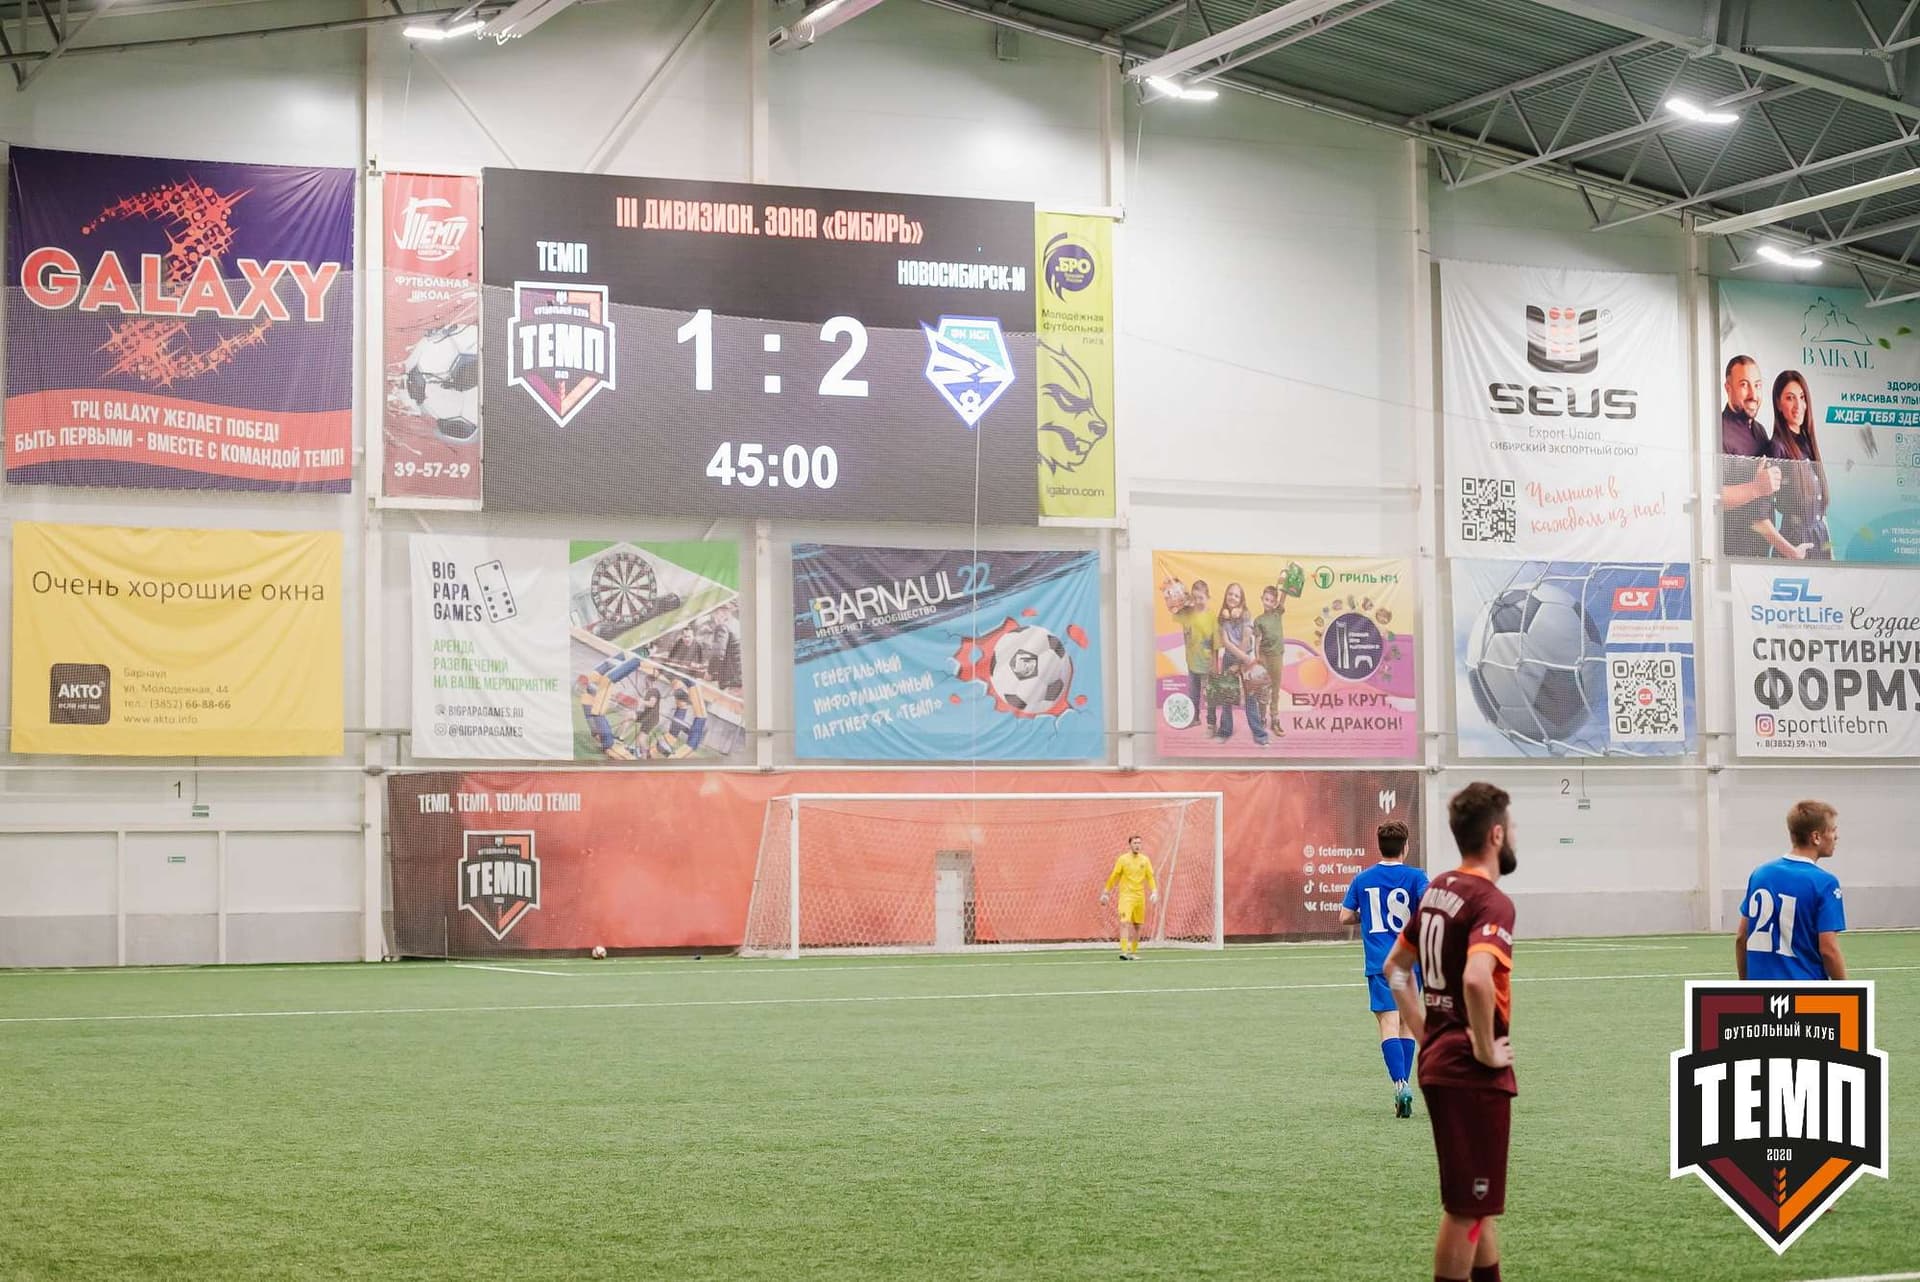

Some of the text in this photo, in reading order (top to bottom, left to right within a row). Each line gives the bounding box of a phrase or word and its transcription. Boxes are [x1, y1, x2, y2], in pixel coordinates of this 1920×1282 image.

[615, 196, 924, 245] III ДИВИЗИОН. ЗОНА «СИБИРЬ»
[536, 240, 588, 274] ТЕМП
[20, 246, 340, 322] GALAXY
[394, 275, 469, 289] ФУТБОЛЬНАЯ
[898, 259, 1026, 292] НОВОСИБИРСК-М
[411, 290, 450, 301] ШКОЛА
[519, 323, 604, 374] ТЕМП
[677, 308, 713, 391] 1
[818, 316, 869, 397] 2
[1488, 382, 1639, 420] SEUS
[1849, 393, 1899, 405] КРАСИВАЯ
[1901, 396, 1920, 406] УЛЫ
[71, 400, 280, 443] ТРЦ GALAXY ЖЕЛАЕТ ПОБЕД!
[1834, 410, 1920, 426] ЖДЕТ ТЕБЯ ЗДЕ
[14, 428, 56, 453] БЫТЬ
[59, 427, 133, 449] ПЕРВЫМИ
[147, 431, 204, 459] ВМЕСТЕ
[208, 442, 218, 460] С
[220, 442, 300, 469] КОМАНДОЙ
[303, 447, 344, 468] ТЕМП!
[1489, 440, 1547, 454] СИБИРСКИЙ
[1548, 443, 1612, 457] ЭКСПОРТНЫЙ
[393, 461, 471, 479] 39-57-29
[706, 442, 839, 489] 45:00
[432, 561, 456, 580] BIG
[1339, 573, 1377, 584] ГРИЛЬ
[32, 571, 325, 605] Очень хорошие окна
[433, 583, 470, 601] PAPA
[1770, 578, 1823, 602] SL
[433, 603, 482, 621] GAMES
[871, 605, 938, 627] СООБЩЕСТВО
[1751, 605, 1844, 624] SportLife
[433, 639, 475, 655] АРЕНДА
[433, 657, 509, 673] РАЗВЛЕЧЕНИЙ
[813, 655, 902, 688] ГЕНЕРАЛЬНЫЙ
[58, 683, 102, 699] АКТО
[433, 675, 559, 693] НА ВАШЕ МЕРОПРИЯТИЕ
[813, 672, 934, 715] ИНФОРМАЦИОННЫЙ
[1292, 693, 1393, 709] БУДЬ КРУТ,
[448, 705, 524, 719] BIGPAPAGAMES.RU
[448, 724, 524, 739] @BIGPAPAGAMES
[812, 713, 870, 740] ПАРТНЕР
[870, 708, 894, 726] ФК
[1293, 716, 1403, 733] КАК ДРАКОН!
[1778, 715, 1888, 737] sportlifebrn
[1560, 779, 1570, 795] 2
[417, 793, 581, 814] ТЕМП, ТЕМП, ТОЛЬКО ТЕМП!
[1318, 845, 1366, 859] fctemp.ru
[1318, 863, 1334, 874] ФК
[467, 861, 532, 898] ТЕМП
[1364, 887, 1411, 934] 18
[1746, 888, 1797, 958] 21
[1419, 911, 1447, 991] 10
